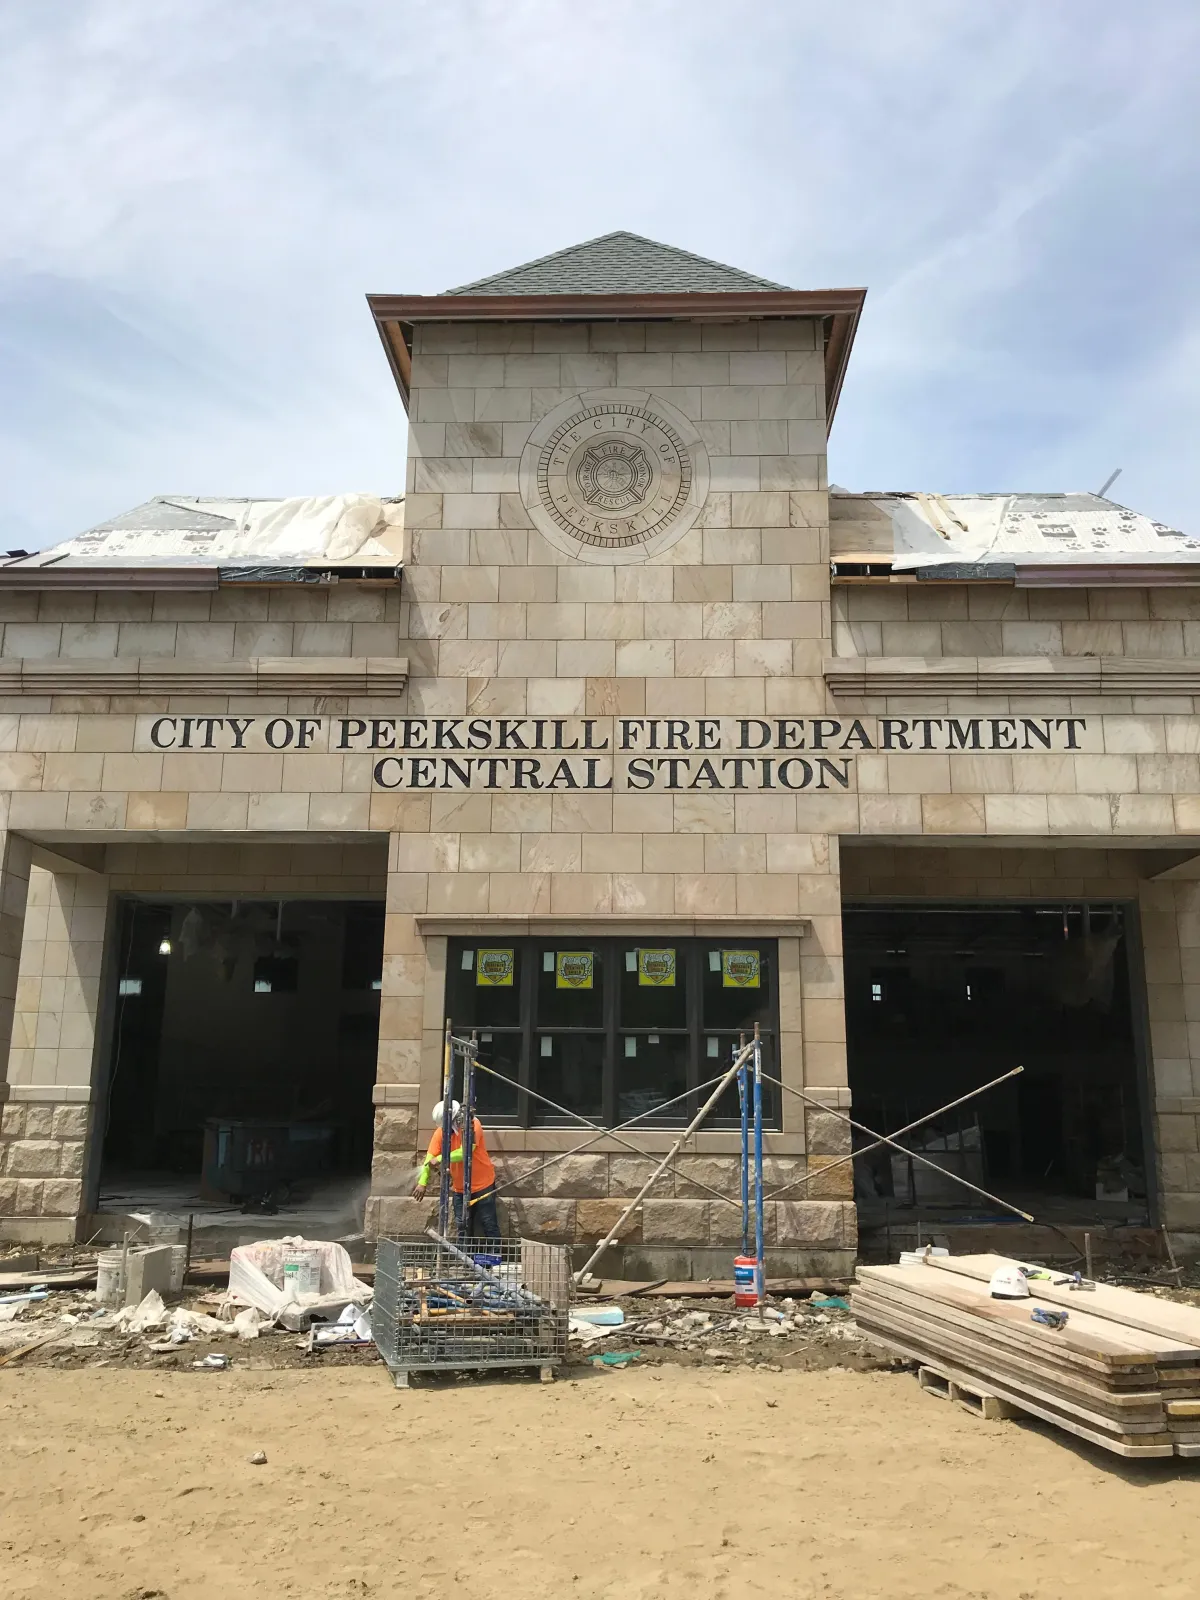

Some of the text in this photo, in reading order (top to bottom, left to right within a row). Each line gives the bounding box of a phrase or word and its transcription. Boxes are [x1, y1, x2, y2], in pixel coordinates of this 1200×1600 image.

[553, 417, 676, 466] THE CITY OF
[601, 446, 626, 455] FIRE
[637, 461, 646, 487] HONOR
[556, 494, 673, 534] PEEKSKILL
[597, 495, 631, 505] RESCUE
[150, 717, 1087, 750] CITY OF PEEKSKILL FIRE DEPARTMENT
[373, 757, 853, 789] CENTRAL STATION
